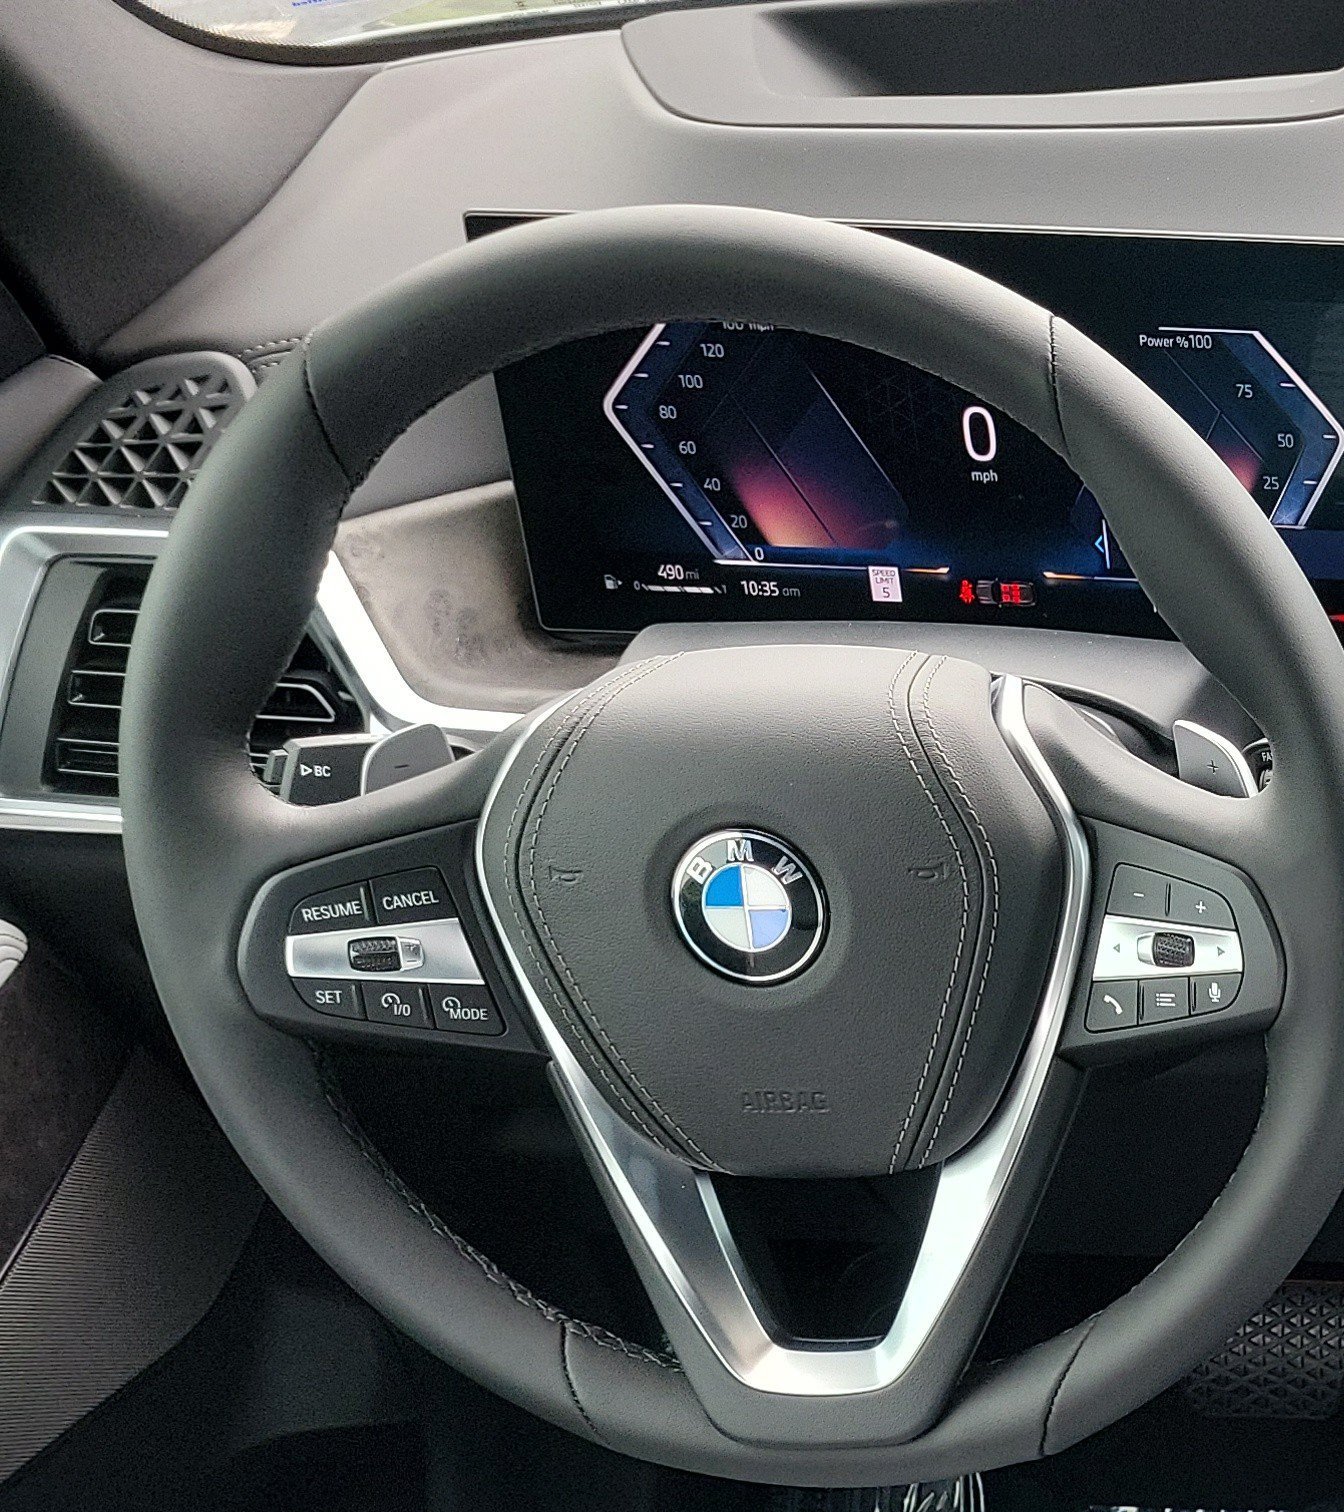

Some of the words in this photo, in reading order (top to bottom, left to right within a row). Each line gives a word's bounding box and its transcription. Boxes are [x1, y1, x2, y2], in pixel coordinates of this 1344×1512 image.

[1139, 334, 1174, 347] Power
[700, 343, 725, 358] 120
[677, 374, 703, 389] 100
[1235, 384, 1253, 398] 75
[658, 405, 677, 419] 80
[962, 406, 997, 462] 0
[1277, 433, 1294, 448] 50
[678, 441, 697, 455] 60
[703, 477, 721, 492] 40
[971, 469, 998, 485] mph
[1263, 476, 1280, 490] 25
[730, 514, 748, 529] 20
[754, 546, 765, 561] 0
[657, 564, 684, 581] 490
[685, 568, 700, 580] mi
[871, 569, 896, 579] SPEED
[740, 579, 780, 598] 10:35
[781, 586, 801, 598] am
[875, 576, 894, 586] LIMIT
[882, 586, 891, 600] 5
[686, 839, 803, 886] BMW
[382, 890, 439, 911] CANCEL
[302, 900, 363, 922] RESUME
[315, 990, 342, 1004] SET
[449, 1007, 488, 1021] MODE
